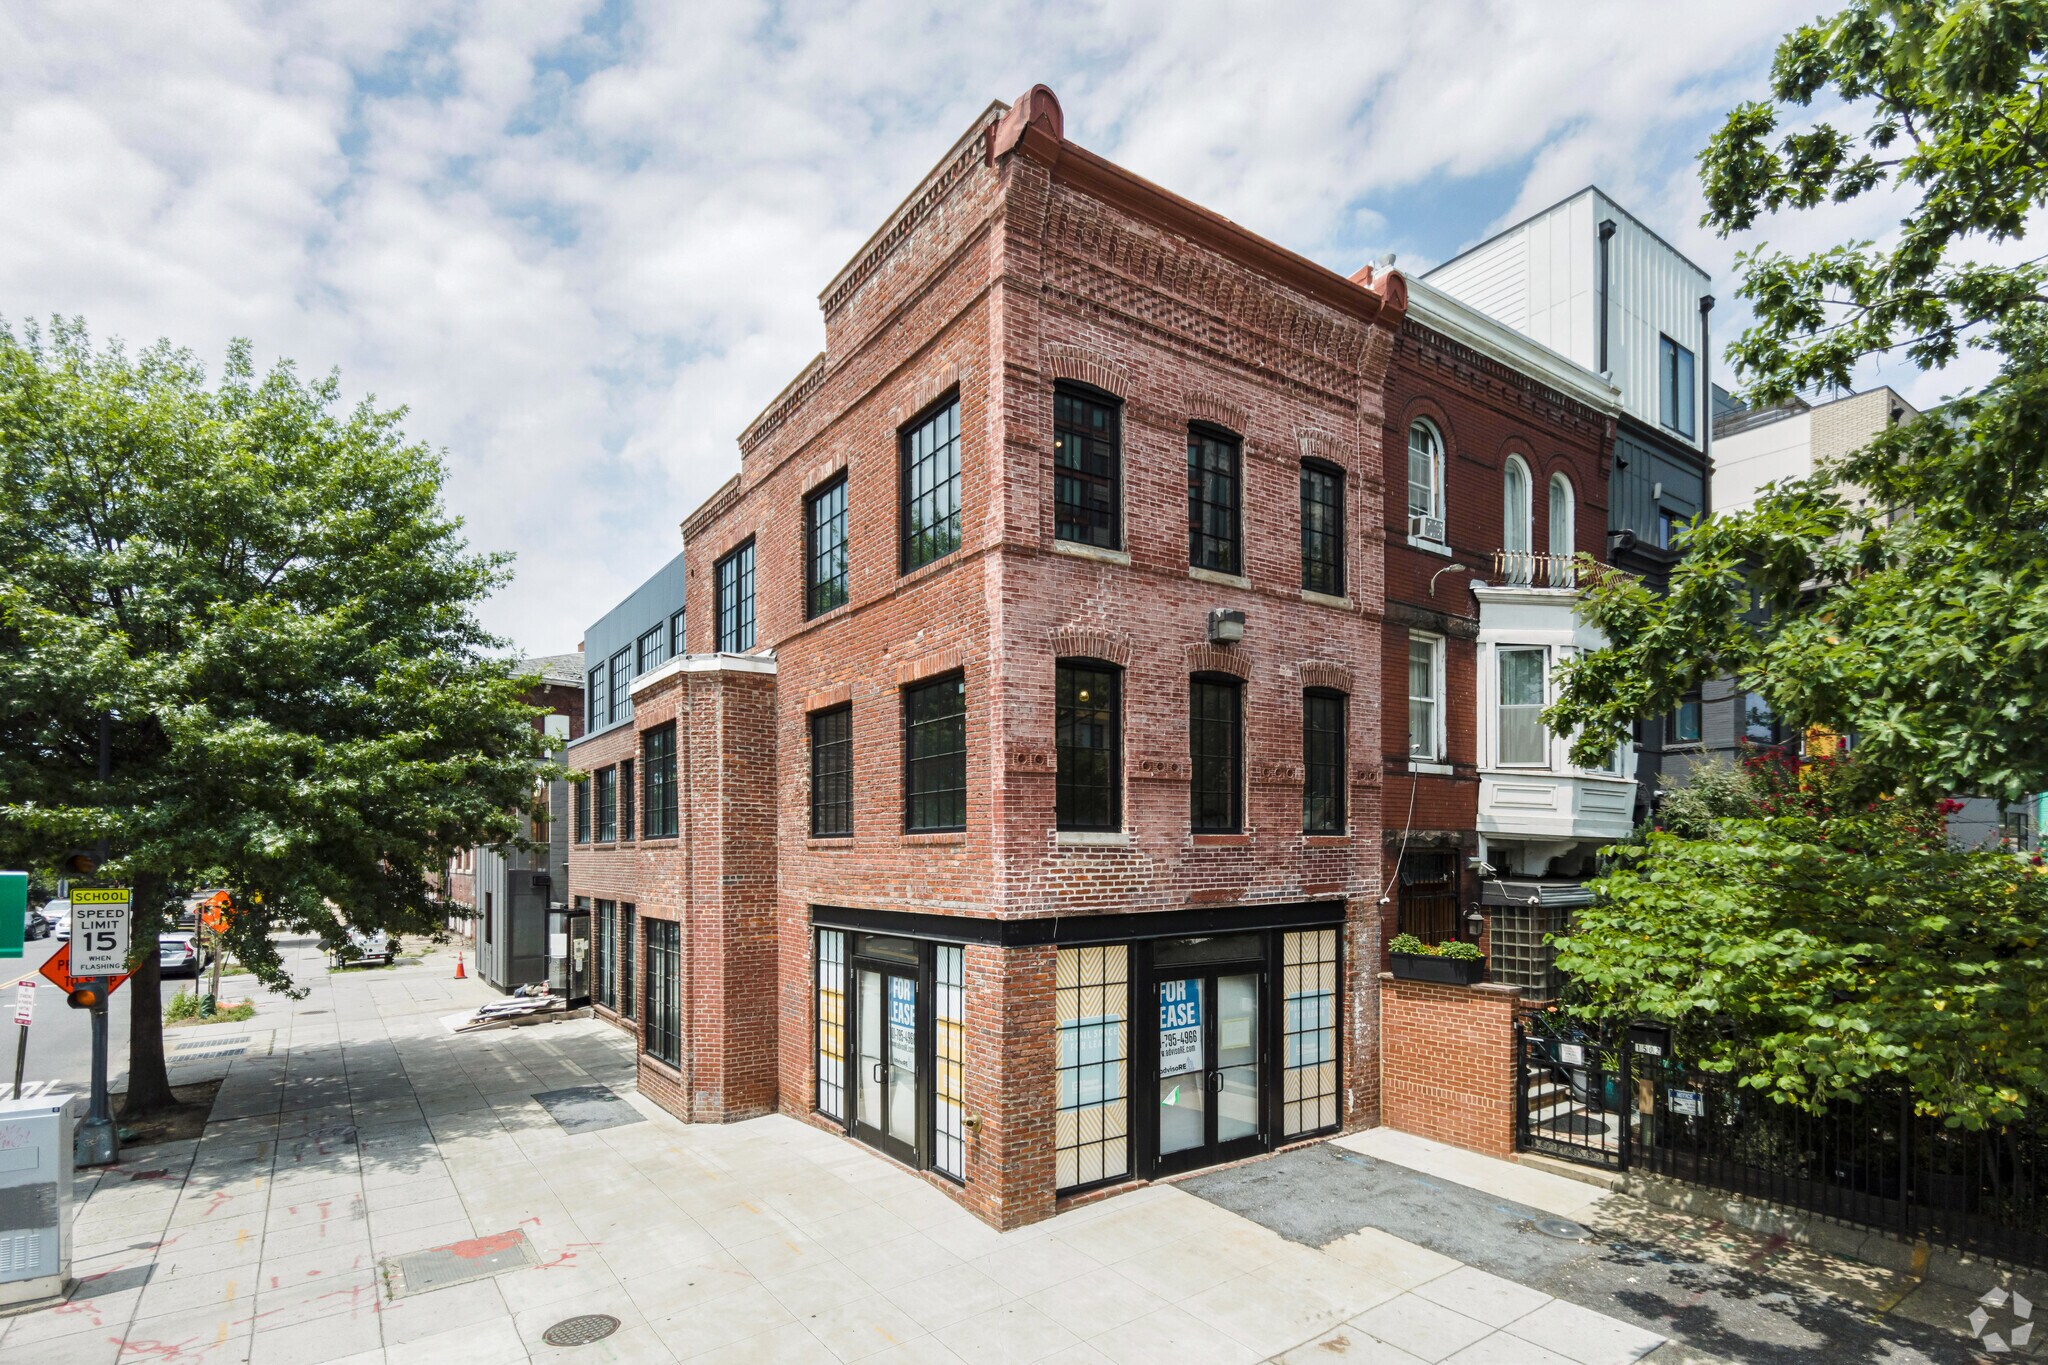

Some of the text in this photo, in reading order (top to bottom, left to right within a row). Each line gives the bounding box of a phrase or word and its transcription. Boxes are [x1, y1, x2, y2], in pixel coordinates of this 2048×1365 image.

[75, 892, 127, 901] SCHOOL
[77, 910, 124, 918] SPEED
[81, 921, 119, 929] LIMIT
[83, 932, 117, 951] 15
[893, 977, 911, 1001] FOR
[1160, 980, 1186, 1003] FOR
[1160, 1002, 1195, 1028] EASE
[1160, 1030, 1197, 1048] -795-4966
[1637, 1044, 1660, 1055] 1502
